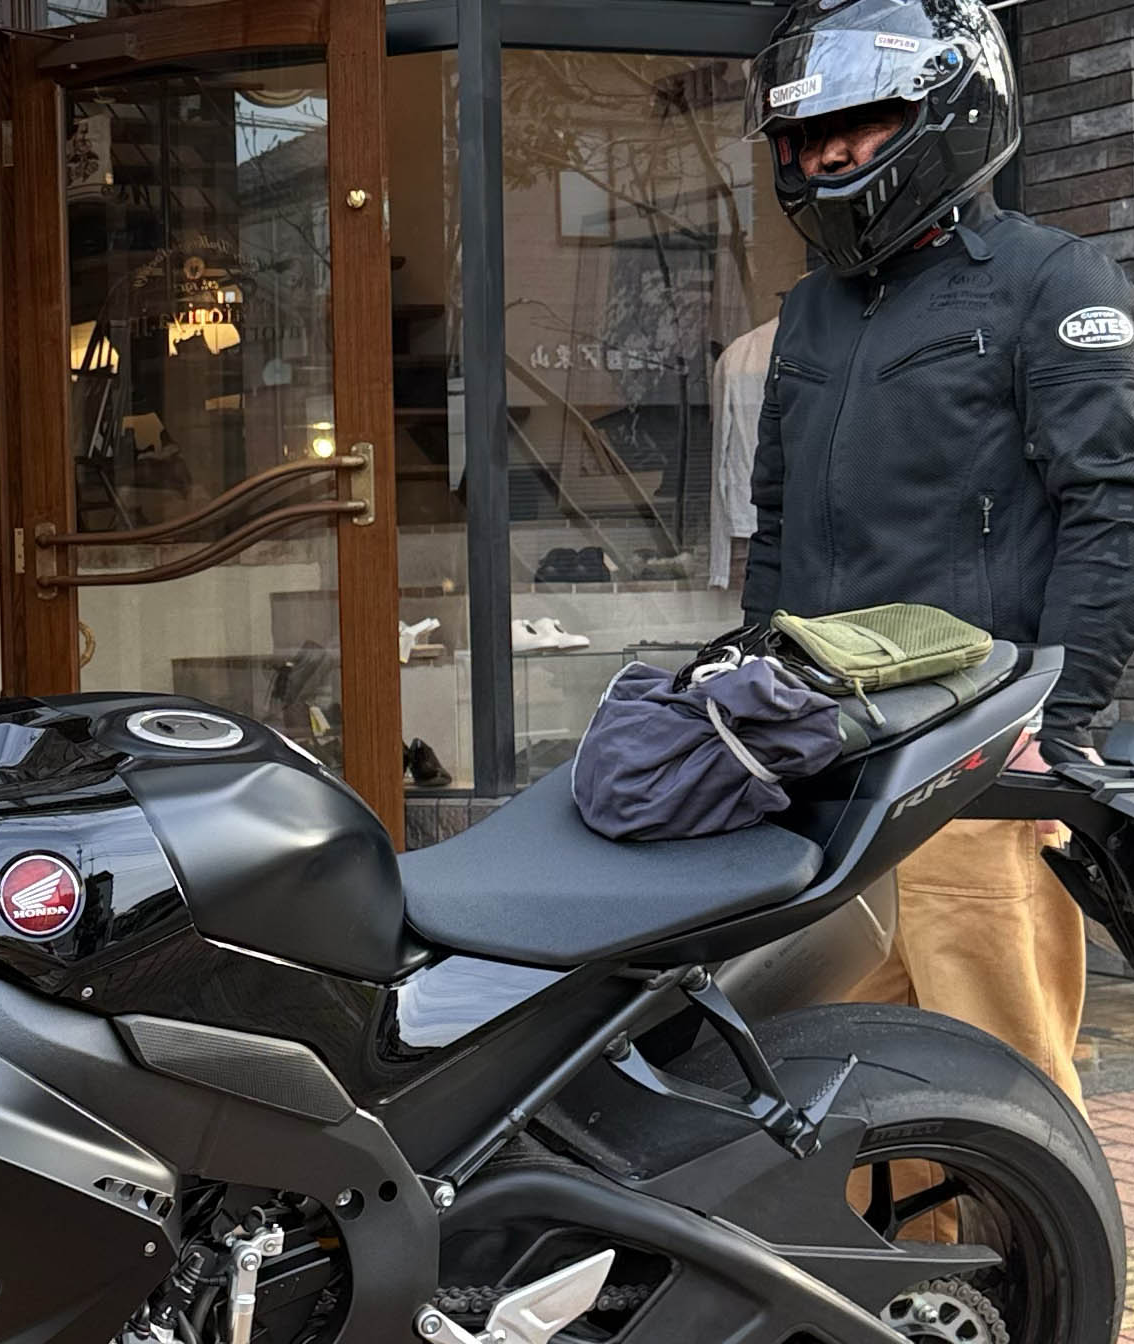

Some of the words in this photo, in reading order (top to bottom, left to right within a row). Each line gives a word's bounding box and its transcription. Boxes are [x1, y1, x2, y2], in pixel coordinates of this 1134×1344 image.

[878, 36, 916, 49] SIMPSON
[772, 78, 817, 105] SIMPSON
[1066, 318, 1131, 338] BATES
[12, 905, 69, 919] HONDA
